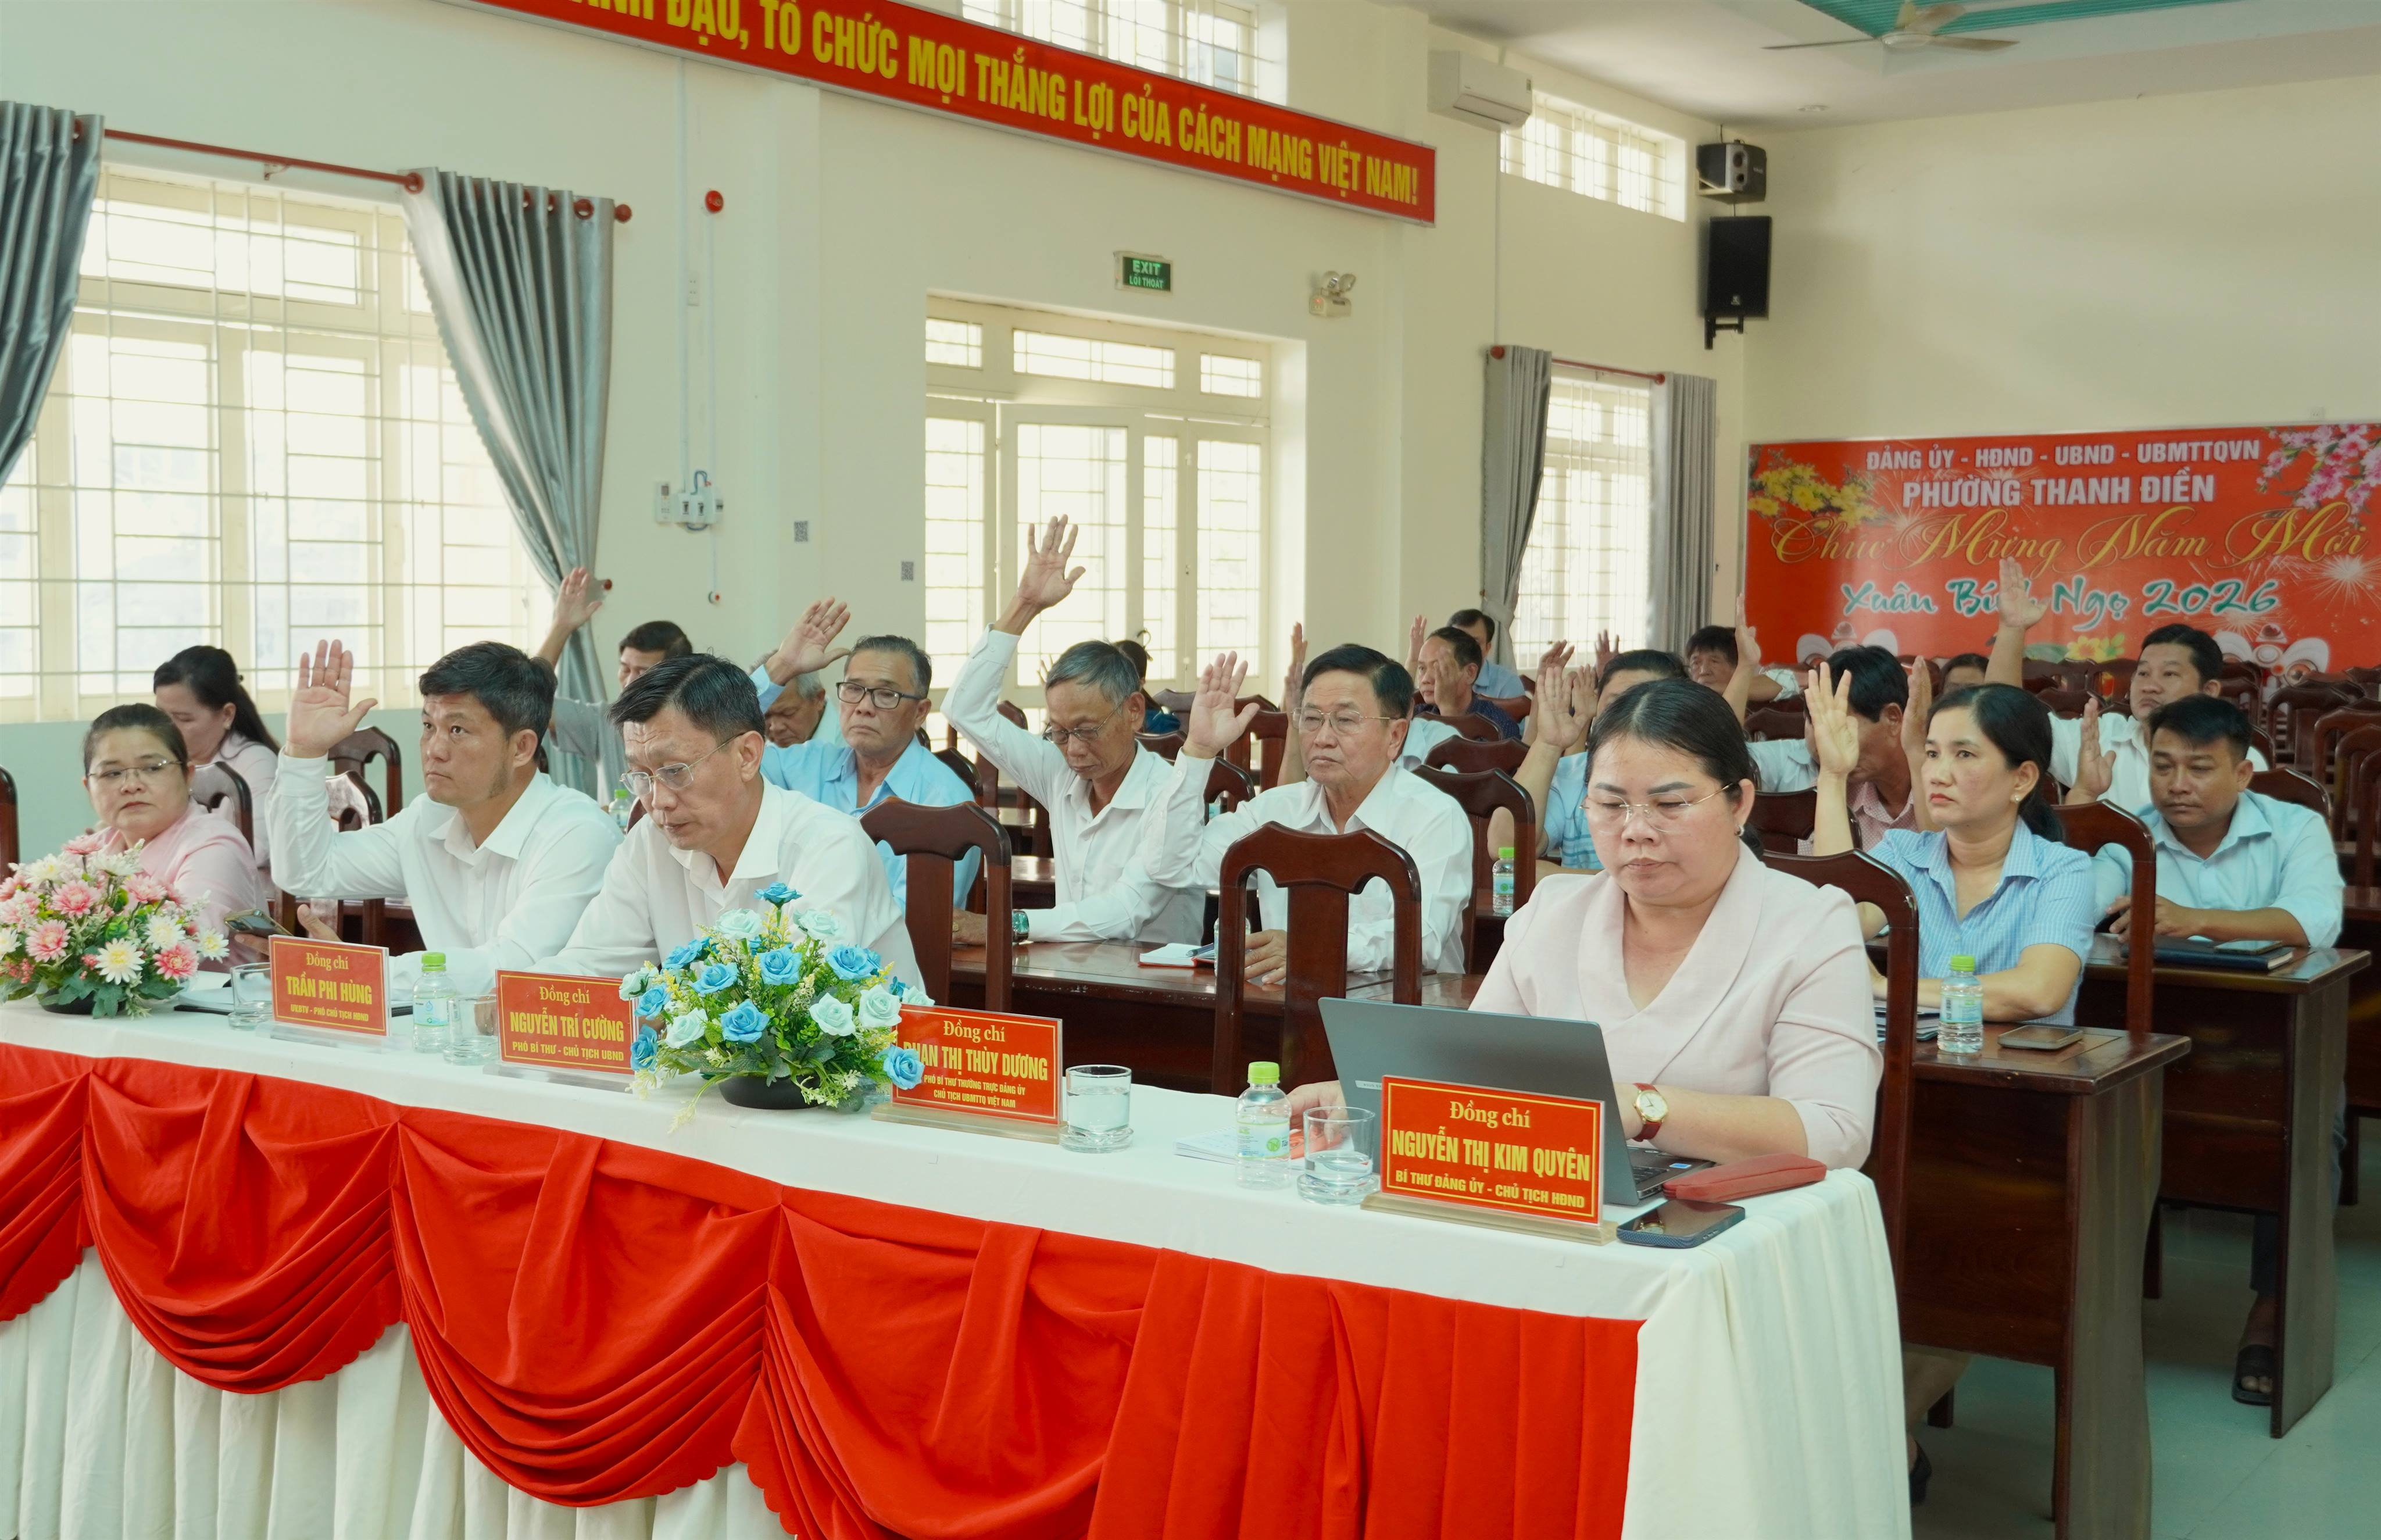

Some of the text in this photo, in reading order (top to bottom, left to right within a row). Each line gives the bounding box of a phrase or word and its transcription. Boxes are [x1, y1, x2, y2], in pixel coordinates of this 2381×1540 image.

[812, 13, 899, 79] CHỨC
[908, 35, 966, 103] MỌI
[974, 46, 1066, 120] THẮNG
[1074, 79, 1114, 140] LỢI
[1121, 82, 1172, 147] CỦA
[1178, 103, 1240, 163] CÁCH
[1247, 124, 1312, 181] MẠNG
[1318, 141, 1361, 197] VIỆT
[1366, 158, 1418, 205] NAM!
[1132, 259, 1161, 276] EXIT
[1867, 445, 1922, 470] ĐẢNG
[1928, 444, 1954, 469] ỦY
[1975, 446, 2033, 468] HĐND
[2055, 445, 2114, 466] UBND
[2137, 440, 2260, 464] UBMTTQVN
[1903, 466, 2215, 508] PHƯỜNG THANH ĐIỀN
[1883, 508, 2066, 580] Mừng
[2052, 505, 2211, 573] Năm
[2207, 502, 2369, 569] Mới
[1842, 574, 2280, 632] Xuân Bí Ngọ 2026
[306, 951, 349, 971] Đồng chí
[286, 971, 372, 1005] TRẦN PHI HÙNG
[539, 984, 590, 1006] Đồng chí
[339, 1010, 352, 1020] TỊCH
[510, 1007, 624, 1042] NGUYỄN TRÍ CƯỜNG
[943, 1019, 1005, 1043] Đồng chí
[512, 1041, 528, 1052] PHÓ
[531, 1041, 538, 1053] BÍ
[541, 1044, 556, 1055] THƯ
[563, 1045, 579, 1057] CHỦ
[581, 1048, 599, 1060] TỊCH
[602, 1051, 624, 1061] UBND
[942, 1046, 962, 1075] THỊ
[966, 1046, 998, 1074] THÙY
[1002, 1052, 1048, 1081] DƯƠNG
[924, 1074, 1025, 1095] PHÓ BÍ THƯ THƯỜNG TRỰC ĐẢNG ỦY
[934, 1088, 1016, 1108] CHỦ TỊCH UBMTTQ VIỆT NAM
[1450, 1100, 1531, 1128] Đồng chí
[1392, 1126, 1590, 1181] NGUYỄN THỊ KIM QUYÊN
[1396, 1169, 1408, 1183] BÍ
[1410, 1172, 1433, 1187] THƯ
[1435, 1173, 1466, 1192] ĐẢNG
[1469, 1177, 1485, 1194] ỦY
[1495, 1183, 1519, 1199] CHỦ
[1522, 1188, 1548, 1205] TỊCH
[1551, 1192, 1585, 1208] HĐND
